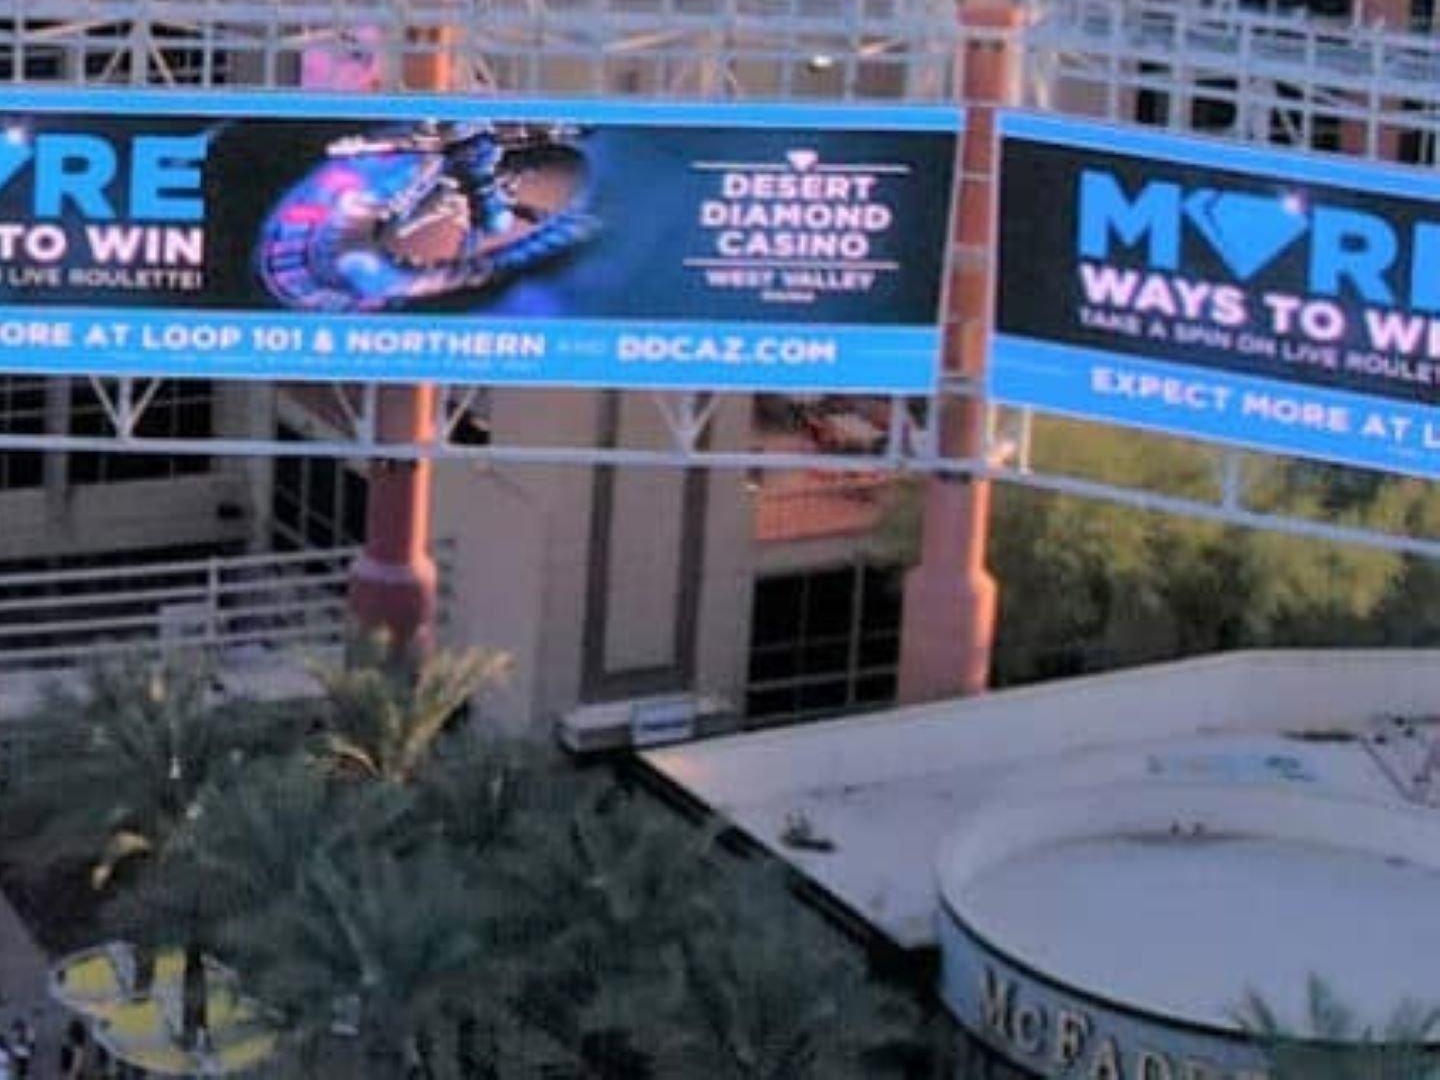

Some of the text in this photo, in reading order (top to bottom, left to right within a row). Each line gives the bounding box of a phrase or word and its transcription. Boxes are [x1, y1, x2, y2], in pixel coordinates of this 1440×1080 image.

[723, 173, 875, 199] DESERT
[700, 200, 893, 230] DIAMOND
[85, 224, 204, 264] WIN
[717, 230, 869, 258] CASINO
[8, 266, 58, 286] LIVE
[69, 267, 202, 289] ROULETTE!
[706, 271, 875, 290] WEST VALLEY
[1078, 263, 1248, 325] WAYS
[1264, 293, 1345, 342] TO
[84, 325, 130, 347] AT
[142, 325, 240, 351] LOOP
[253, 327, 302, 352] 101
[311, 328, 333, 353] &
[347, 329, 545, 357] NORTHERN
[617, 335, 837, 365] DDCAZ.COM
[1078, 307, 1142, 335] TAKE
[1150, 321, 1169, 339] A
[1174, 323, 1232, 350] SPIN
[1236, 336, 1277, 359] ON
[1282, 345, 1338, 369] LIVE
[1091, 368, 1232, 410] EXPECT
[1242, 391, 1351, 433] MORE
[1362, 416, 1412, 444] AT
